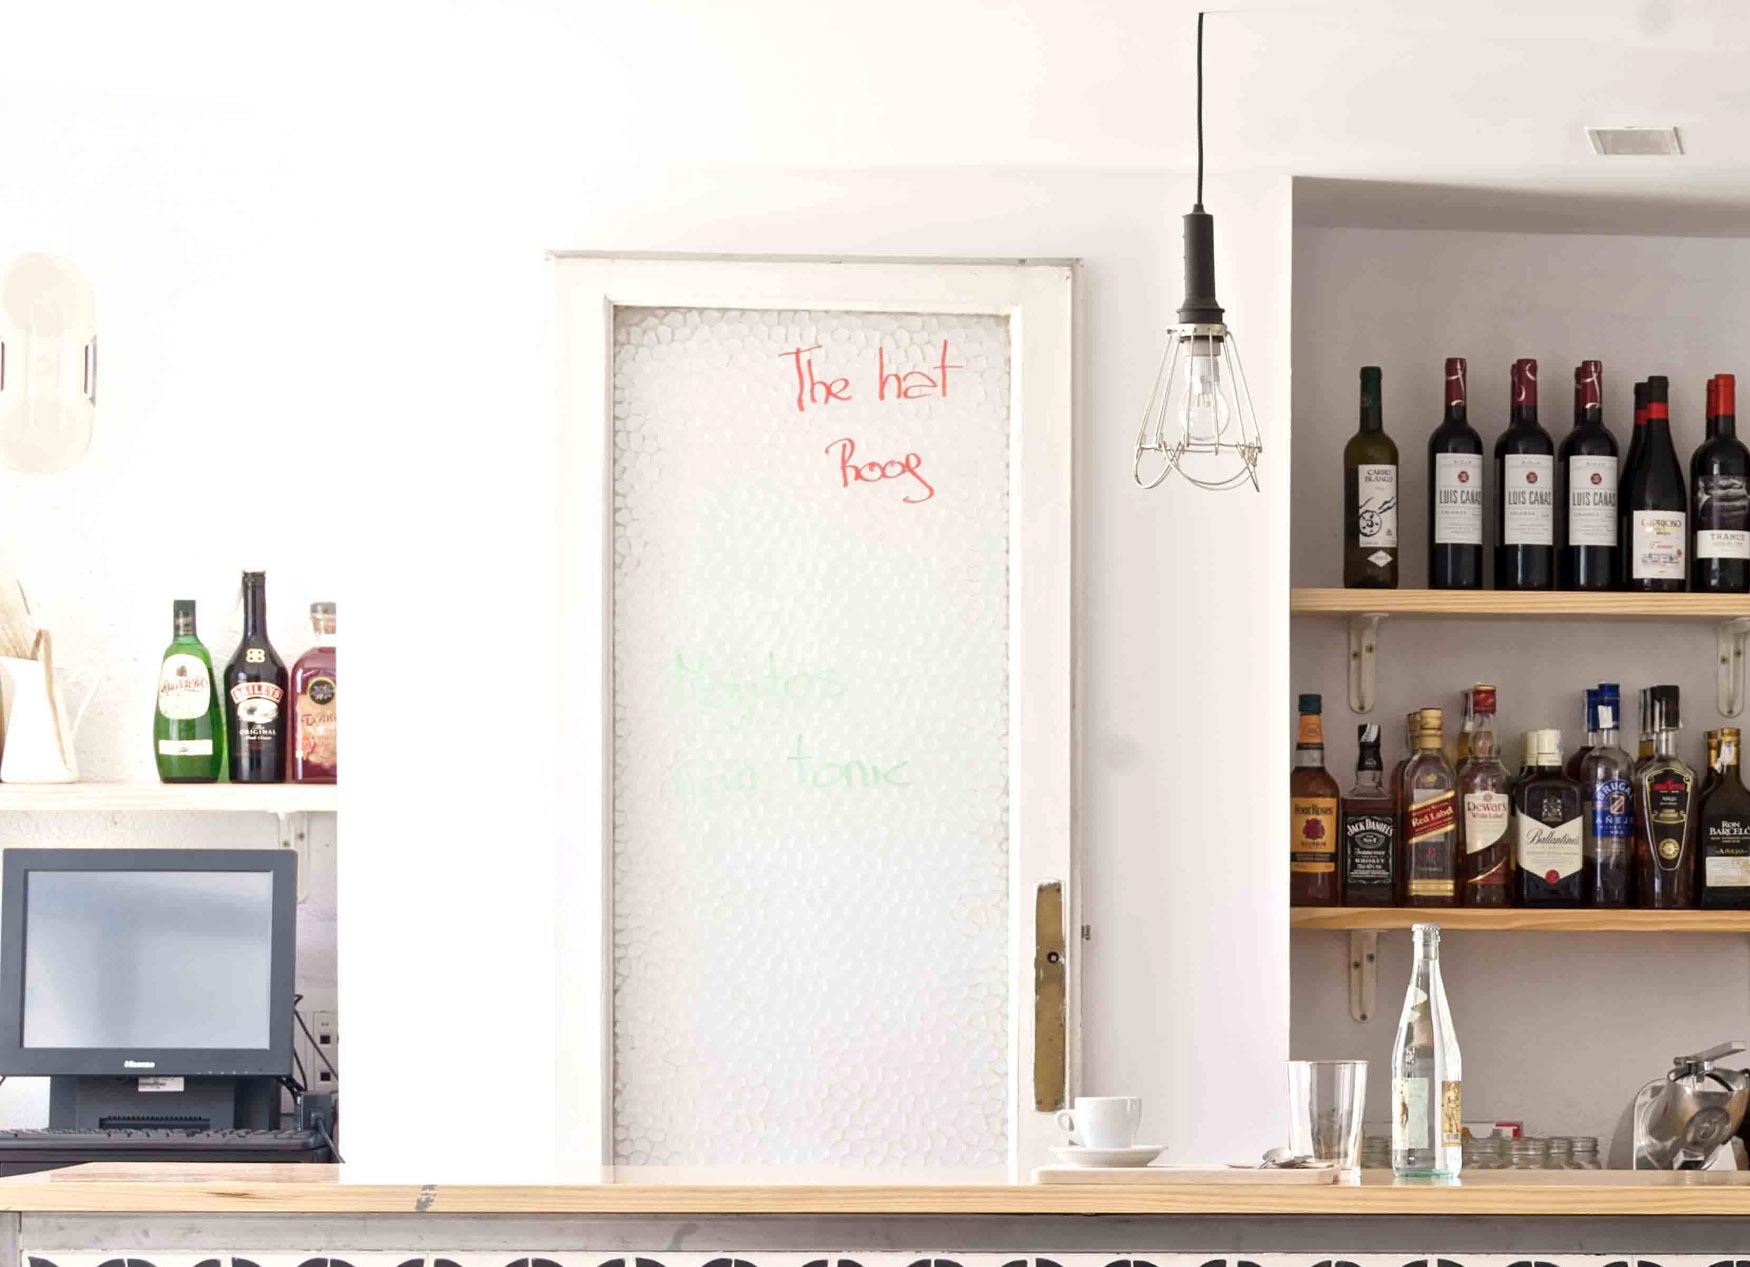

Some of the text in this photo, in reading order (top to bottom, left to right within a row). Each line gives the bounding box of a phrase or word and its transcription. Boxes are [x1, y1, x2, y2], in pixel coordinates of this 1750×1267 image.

[778, 339, 964, 412] The hat
[1439, 489, 1458, 505] LUIS
[1508, 489, 1552, 506] LUIS CAÑAS
[1572, 490, 1616, 508] LUIS CAÑAS
[1411, 805, 1454, 828] Red Label
[1346, 820, 1366, 838] JACK
